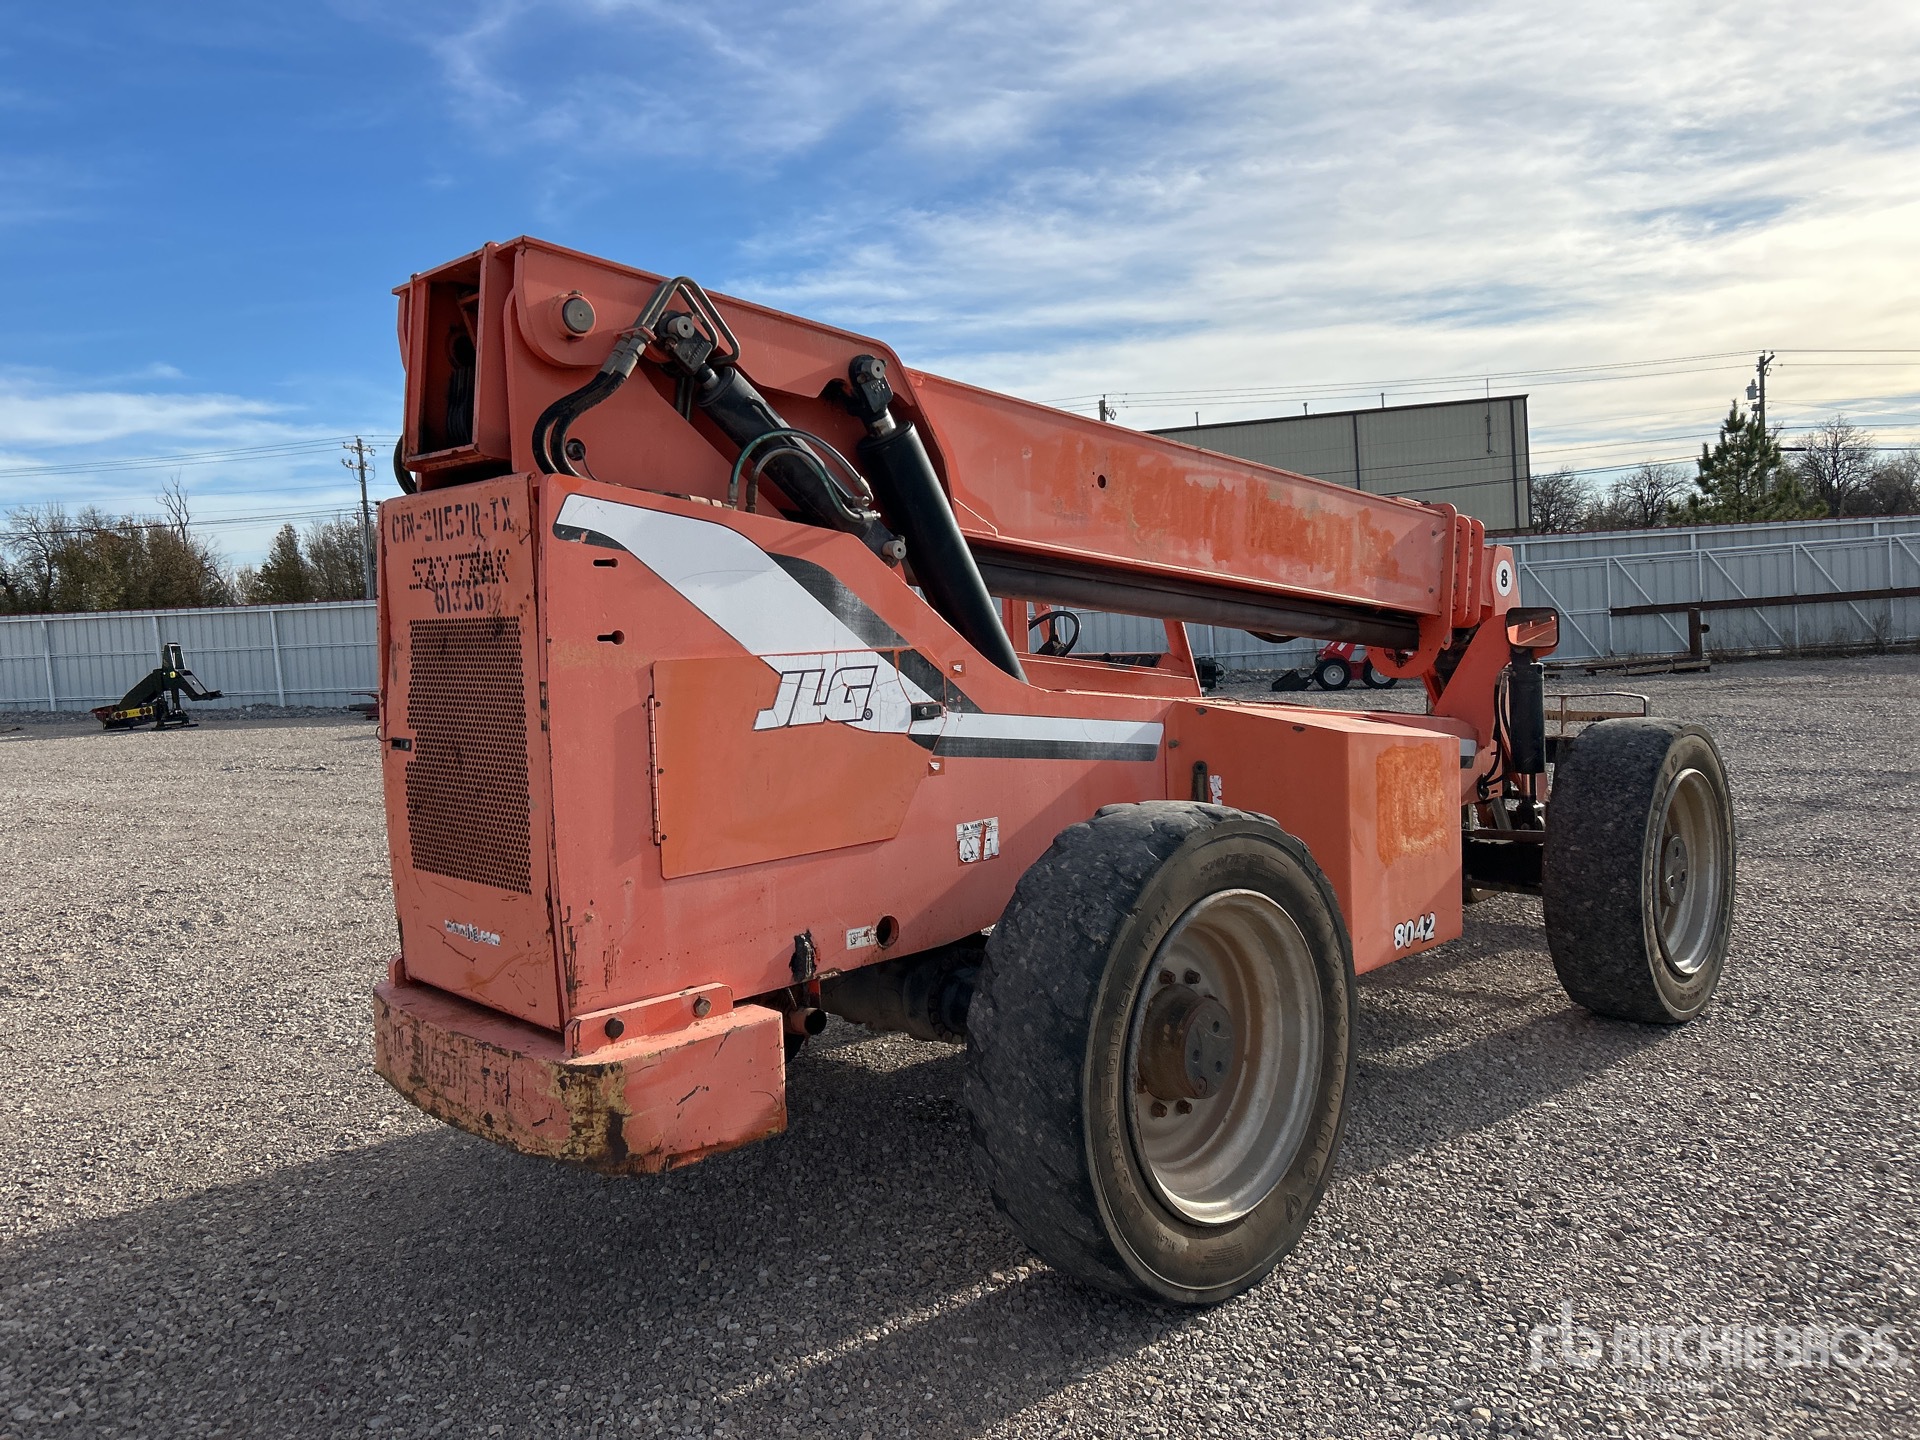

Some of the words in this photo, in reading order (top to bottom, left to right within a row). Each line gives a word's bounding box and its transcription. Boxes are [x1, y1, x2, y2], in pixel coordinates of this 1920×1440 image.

[1501, 569, 1508, 587] 8
[752, 665, 878, 732] JLG
[1393, 911, 1436, 951] 8042
